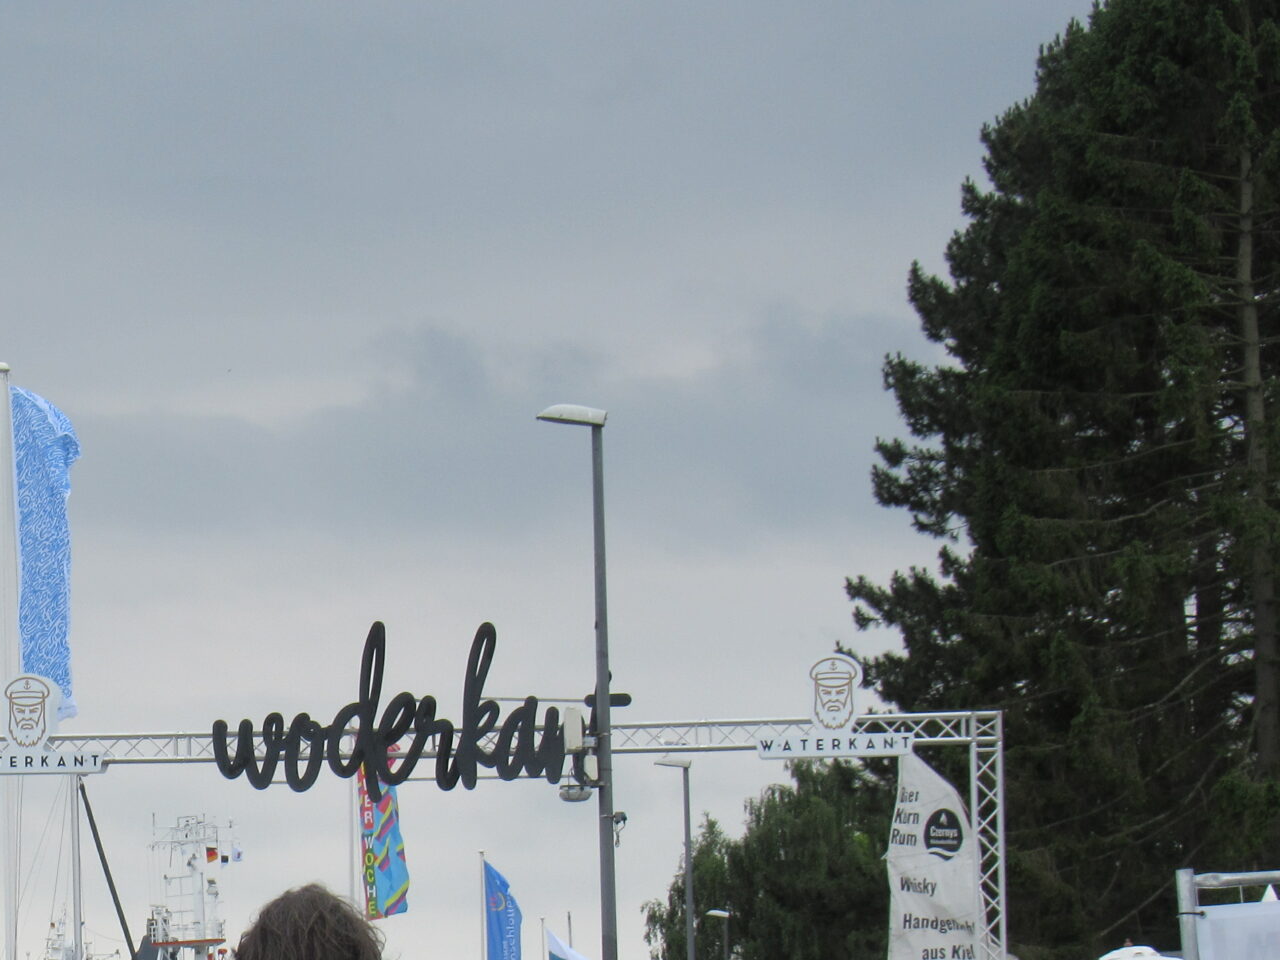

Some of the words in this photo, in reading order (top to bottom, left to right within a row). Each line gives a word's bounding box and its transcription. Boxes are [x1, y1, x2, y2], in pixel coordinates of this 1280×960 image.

[760, 736, 910, 752] WATERKANT
[891, 828, 917, 846] Rum
[922, 945, 946, 960] aus
